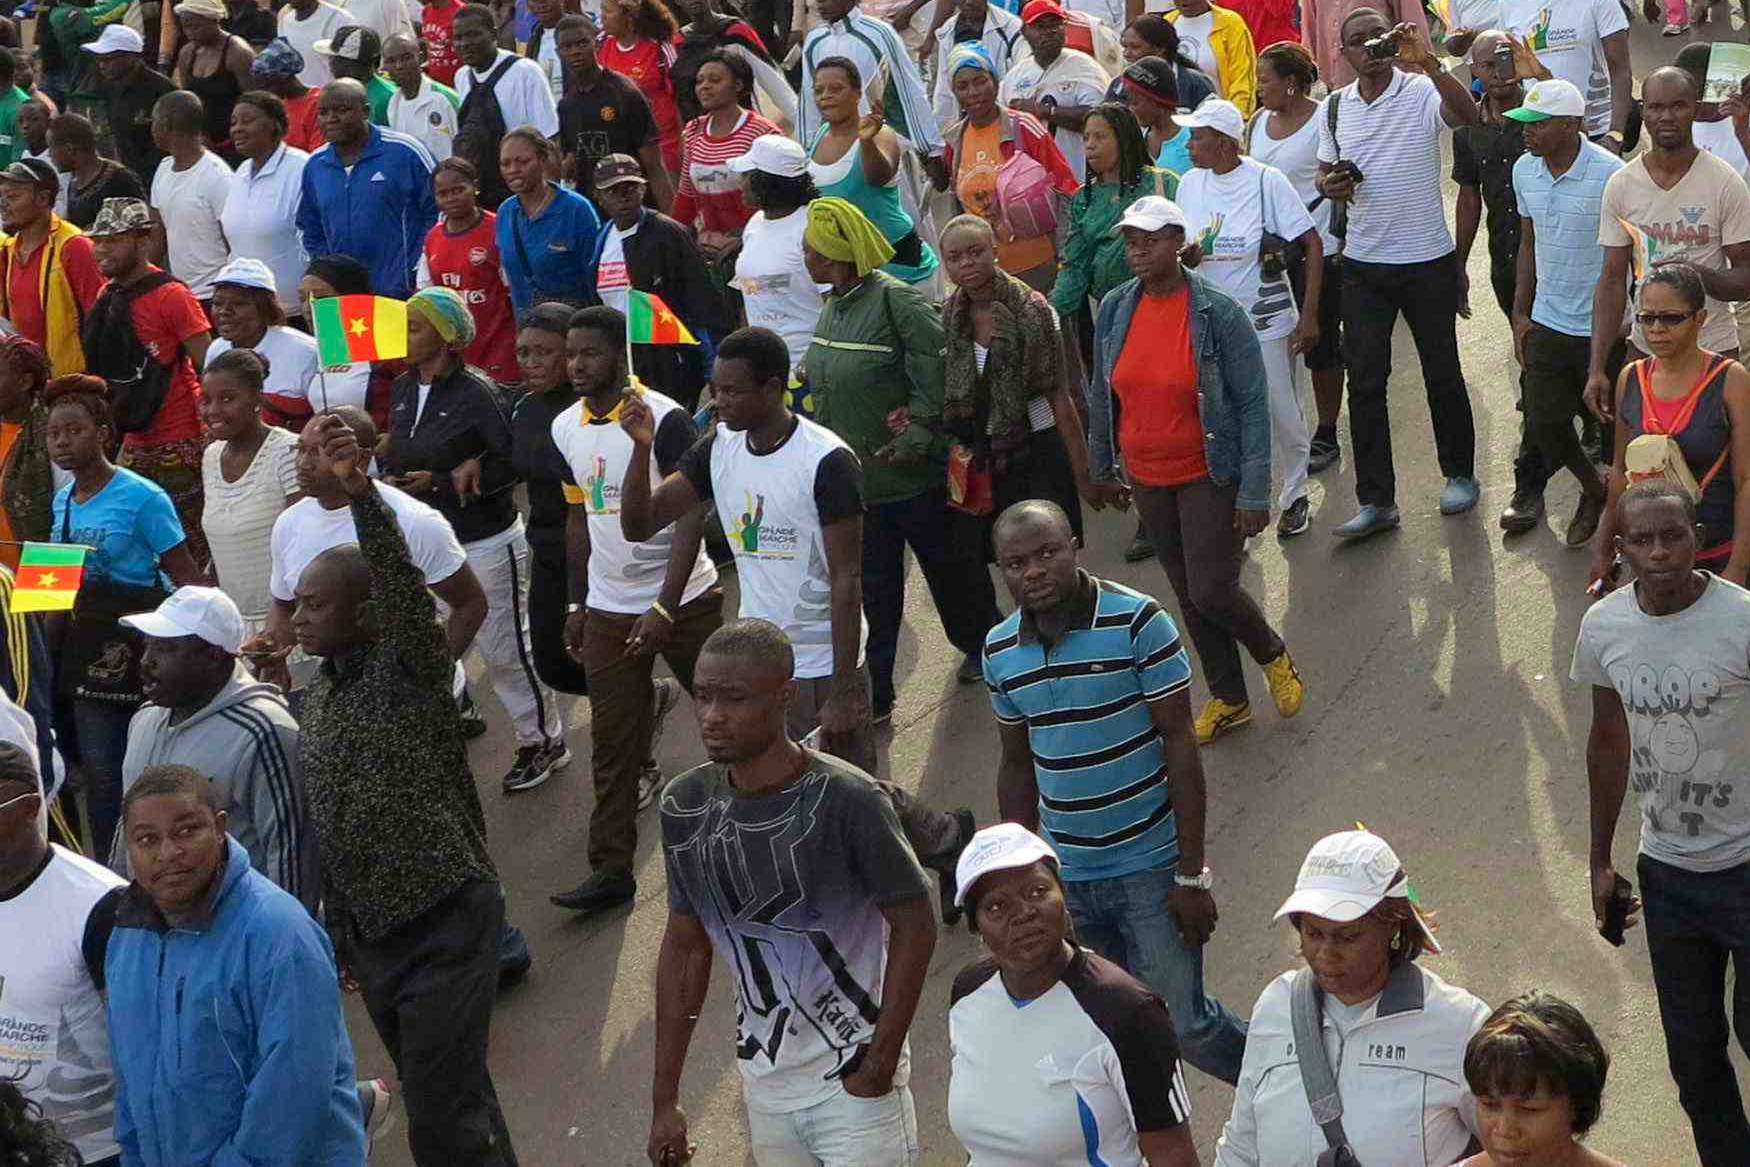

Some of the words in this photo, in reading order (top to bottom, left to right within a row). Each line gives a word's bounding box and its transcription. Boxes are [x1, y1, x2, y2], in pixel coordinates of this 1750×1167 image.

[440, 273, 461, 288] Fly
[1679, 778, 1733, 809] IT'S
[0, 1017, 49, 1033] RANDE
[0, 1029, 49, 1042] ARCHE
